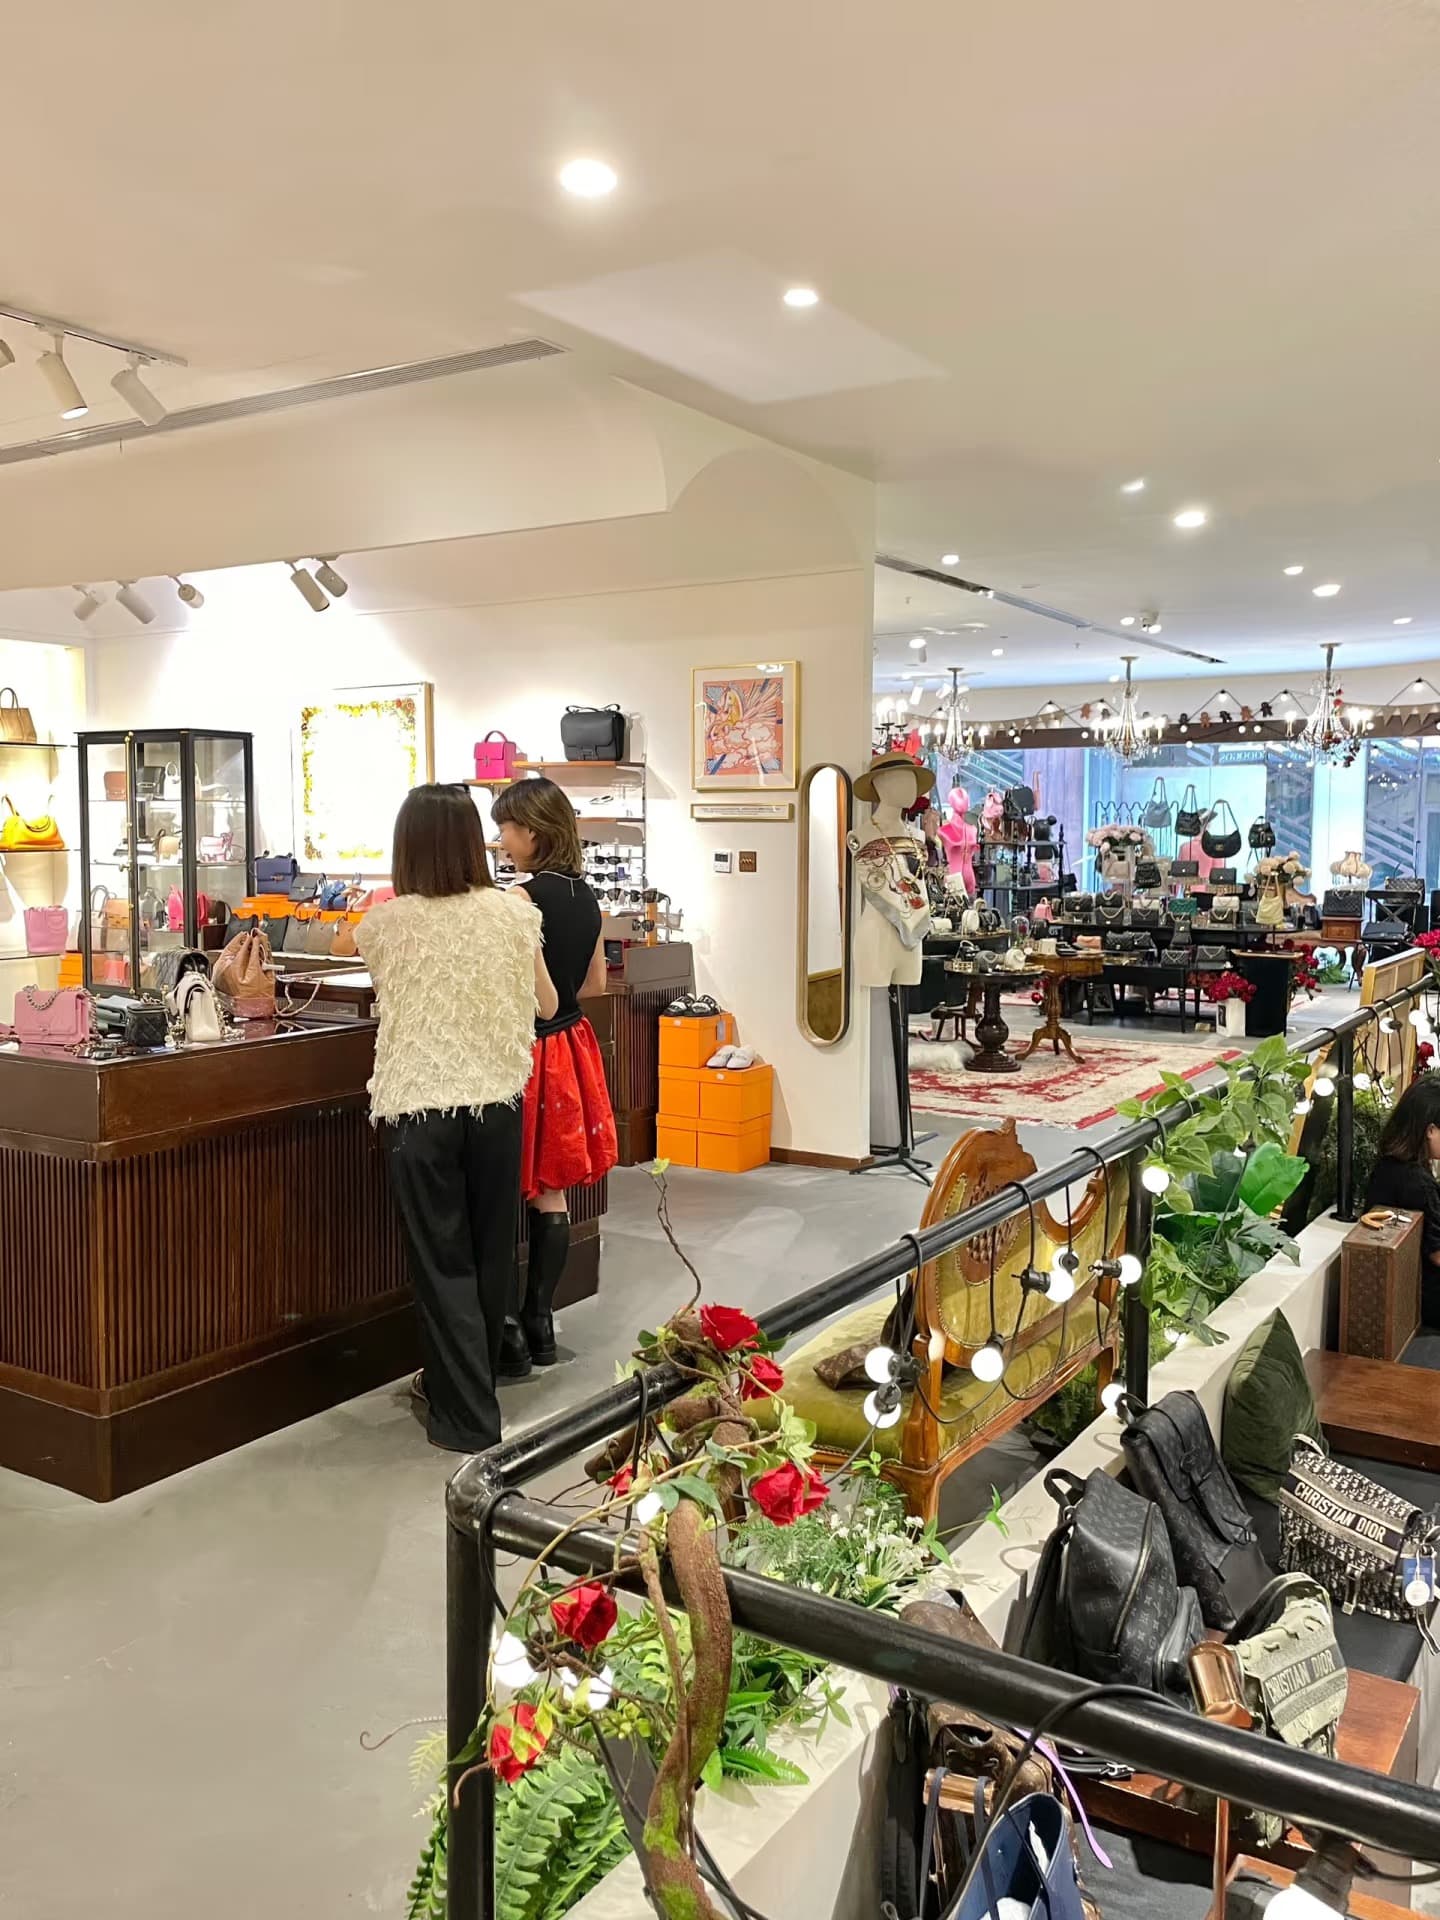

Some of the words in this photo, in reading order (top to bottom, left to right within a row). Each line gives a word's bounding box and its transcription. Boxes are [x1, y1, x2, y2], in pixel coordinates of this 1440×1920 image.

[1294, 1481, 1356, 1527] CHRISTIAN
[1355, 1517, 1386, 1543] DIOR
[1310, 1649, 1336, 1678] DIOR
